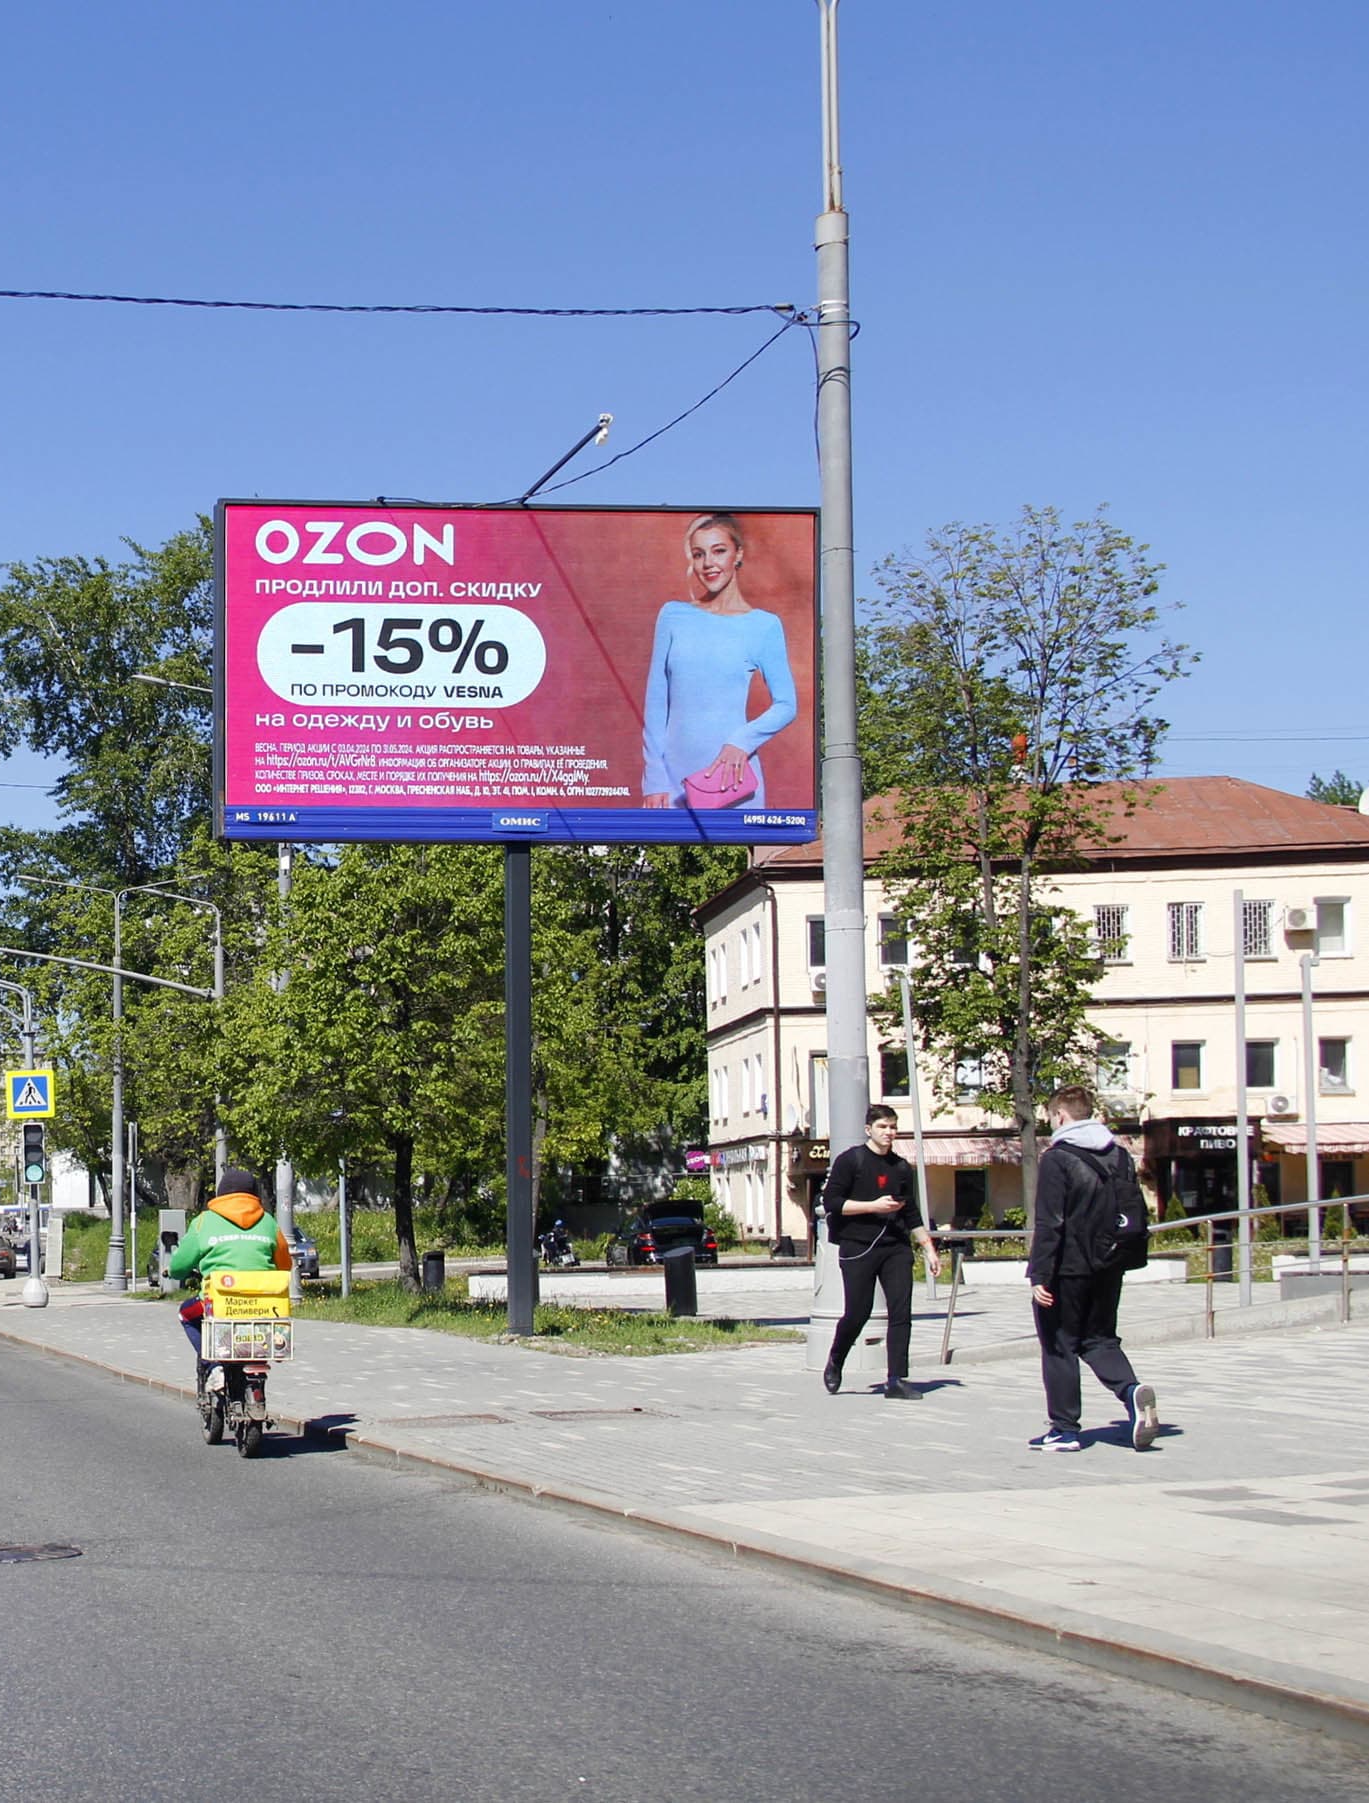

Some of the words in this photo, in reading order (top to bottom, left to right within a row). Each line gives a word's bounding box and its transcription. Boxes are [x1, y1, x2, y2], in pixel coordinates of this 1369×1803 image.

[255, 519, 455, 566] OZON
[255, 579, 383, 597] ПРОДЛИЛИ
[388, 580, 444, 599] ДОП.
[449, 582, 543, 600] СКИДКУ
[291, 683, 317, 697] ПО
[322, 684, 437, 700] ПРОМОКОДУ
[443, 685, 503, 699] VESNA
[255, 714, 286, 727] на
[292, 714, 390, 732] одежду
[397, 715, 411, 728] и
[418, 711, 494, 733] обувь
[371, 744, 382, 754] ПО
[505, 745, 516, 755] НА
[255, 757, 265, 765] НА
[468, 772, 478, 781] НА
[255, 783, 272, 792] ООО
[236, 812, 250, 821] MS
[500, 817, 541, 826] ОМИС
[1178, 1125, 1254, 1136] КРАФТОВЕ
[1200, 1138, 1237, 1149] ПИВО
[225, 1298, 258, 1306] Маркет
[225, 1307, 270, 1316] Деливери
